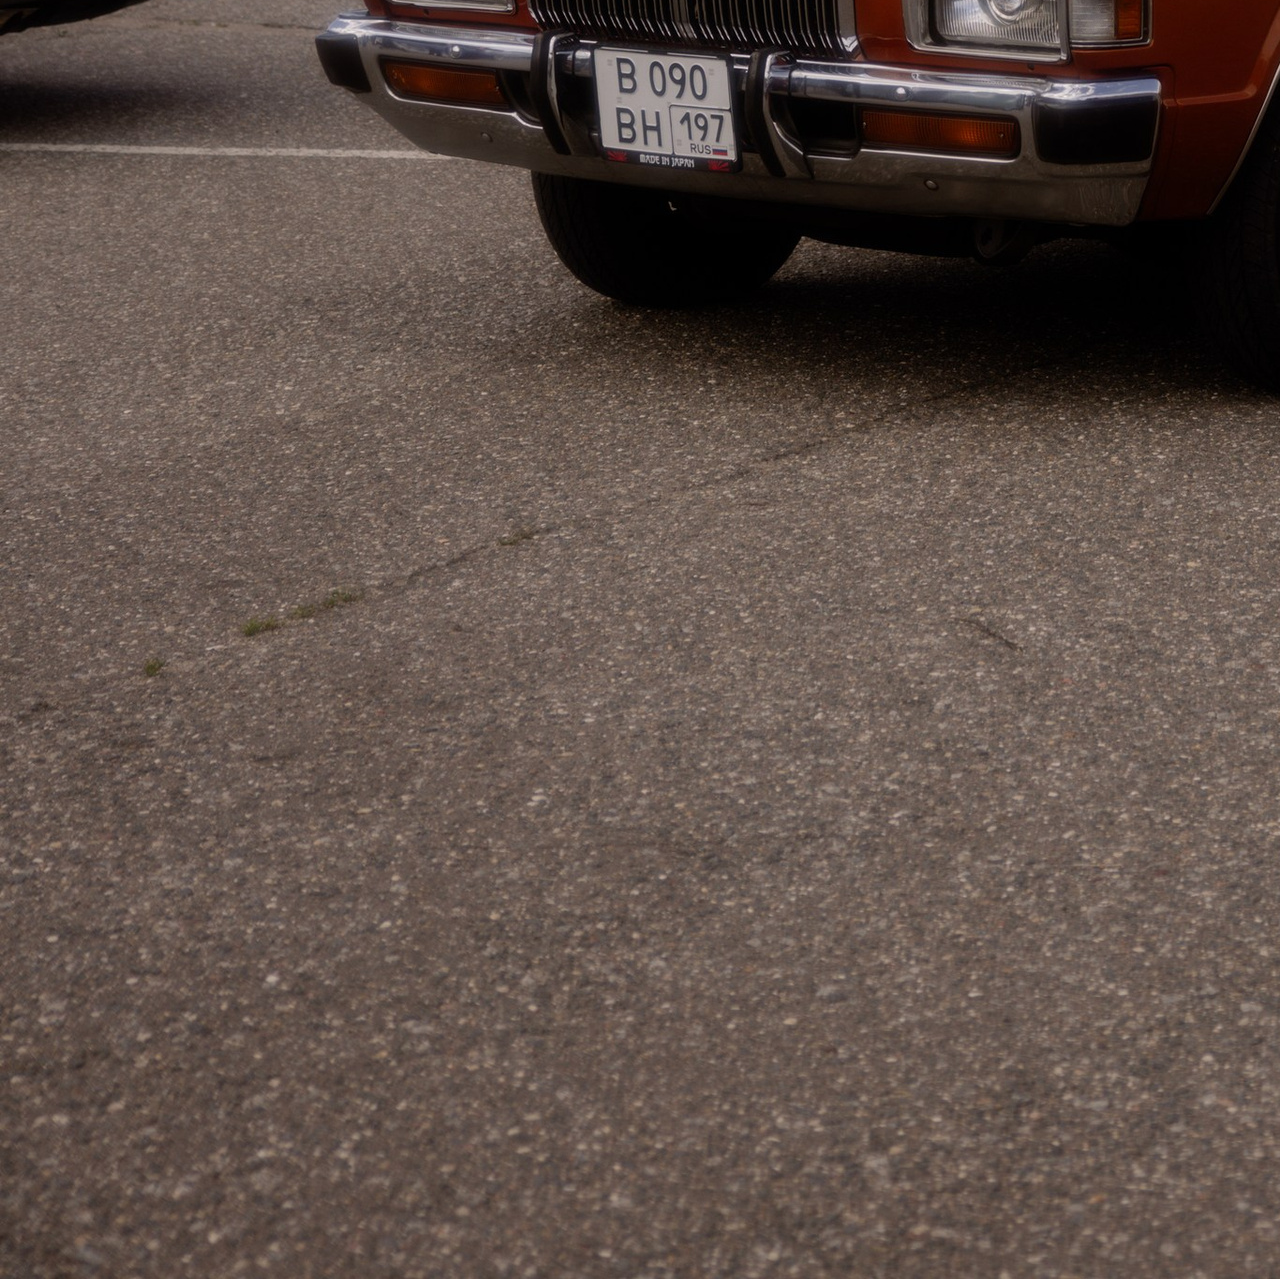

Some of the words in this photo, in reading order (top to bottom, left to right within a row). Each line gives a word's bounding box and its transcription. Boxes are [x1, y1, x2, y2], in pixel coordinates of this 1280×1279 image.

[649, 60, 708, 101] 090
[680, 112, 724, 143] 197
[690, 143, 712, 155] RUS
[639, 154, 660, 165] MADE
[661, 156, 670, 166] IN
[670, 157, 695, 168] JAPAN
